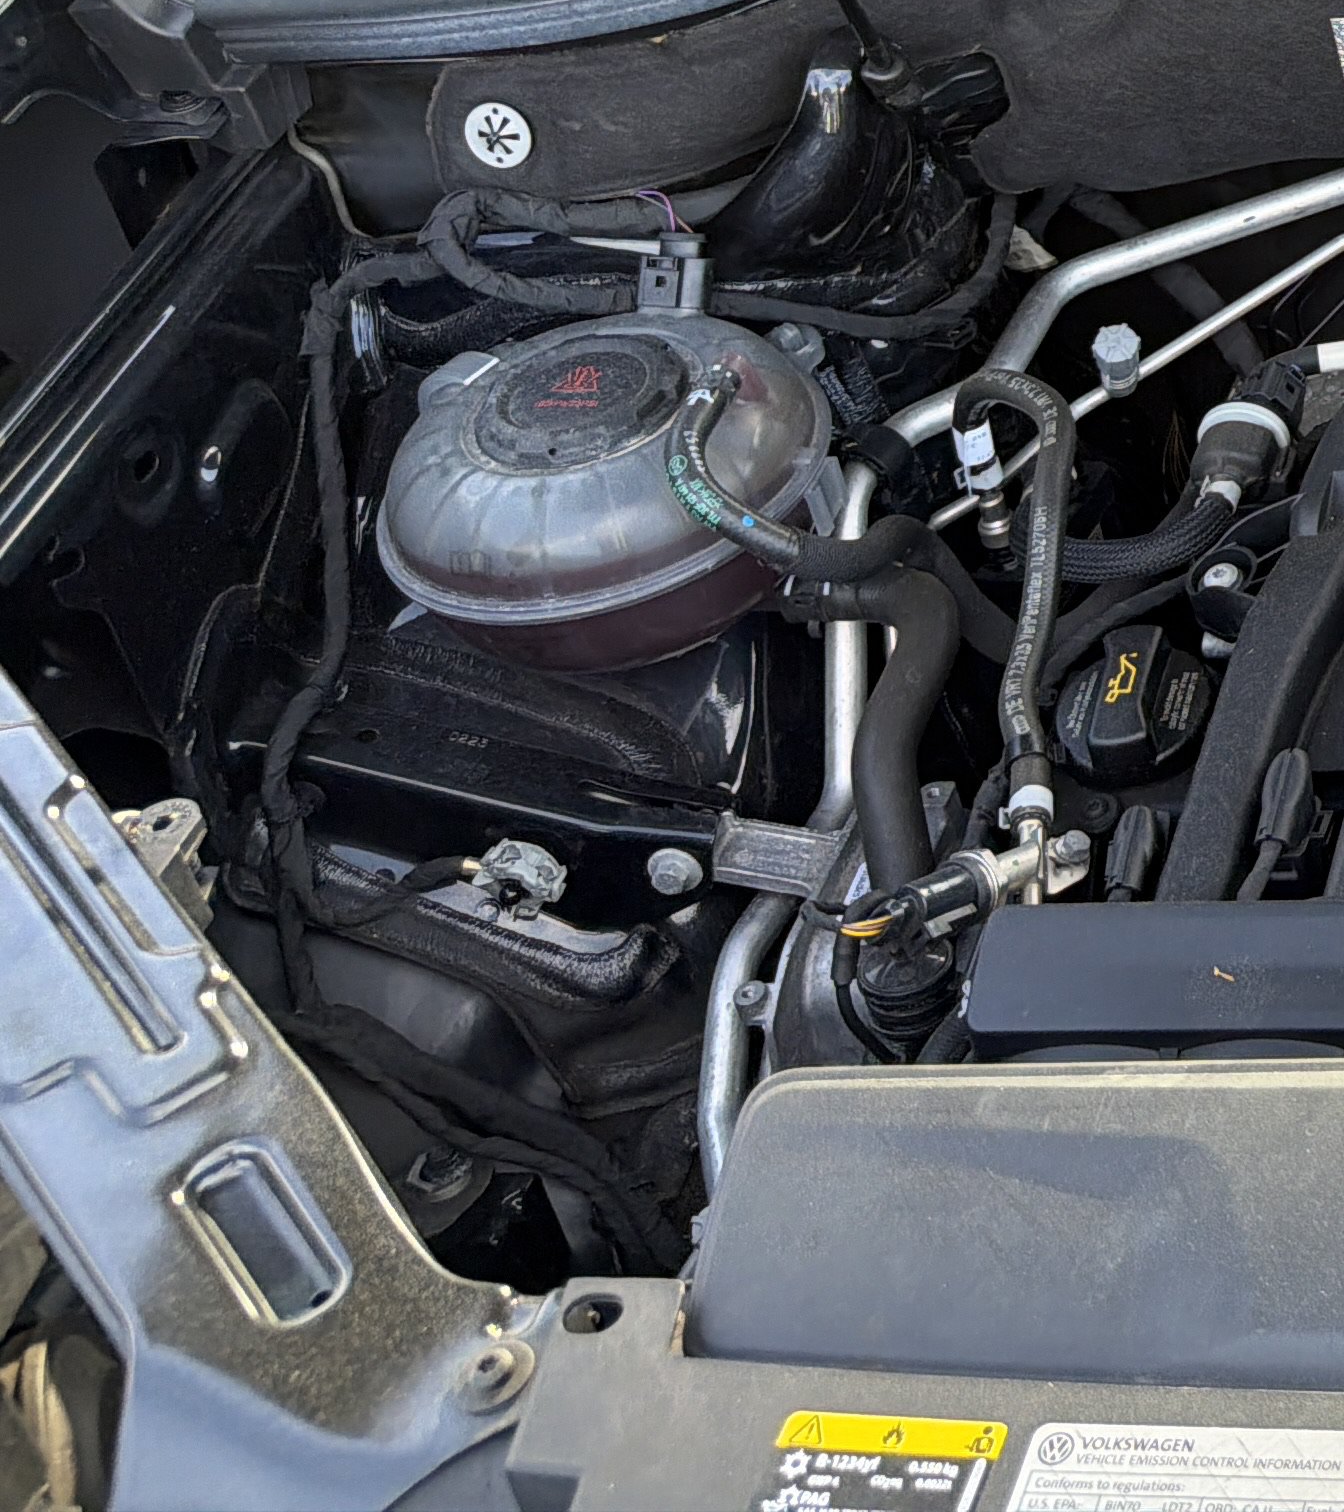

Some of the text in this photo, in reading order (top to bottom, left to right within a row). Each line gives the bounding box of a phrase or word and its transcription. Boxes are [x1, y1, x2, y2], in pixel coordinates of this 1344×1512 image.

[1081, 1436, 1195, 1452] VOLKSWAGEN
[1076, 1453, 1342, 1471] VEHICLE EMISSION CONTROL INFORMATION
[1035, 1476, 1093, 1489] Conforms
[1097, 1479, 1111, 1489] to
[1112, 1479, 1185, 1493] regulations:
